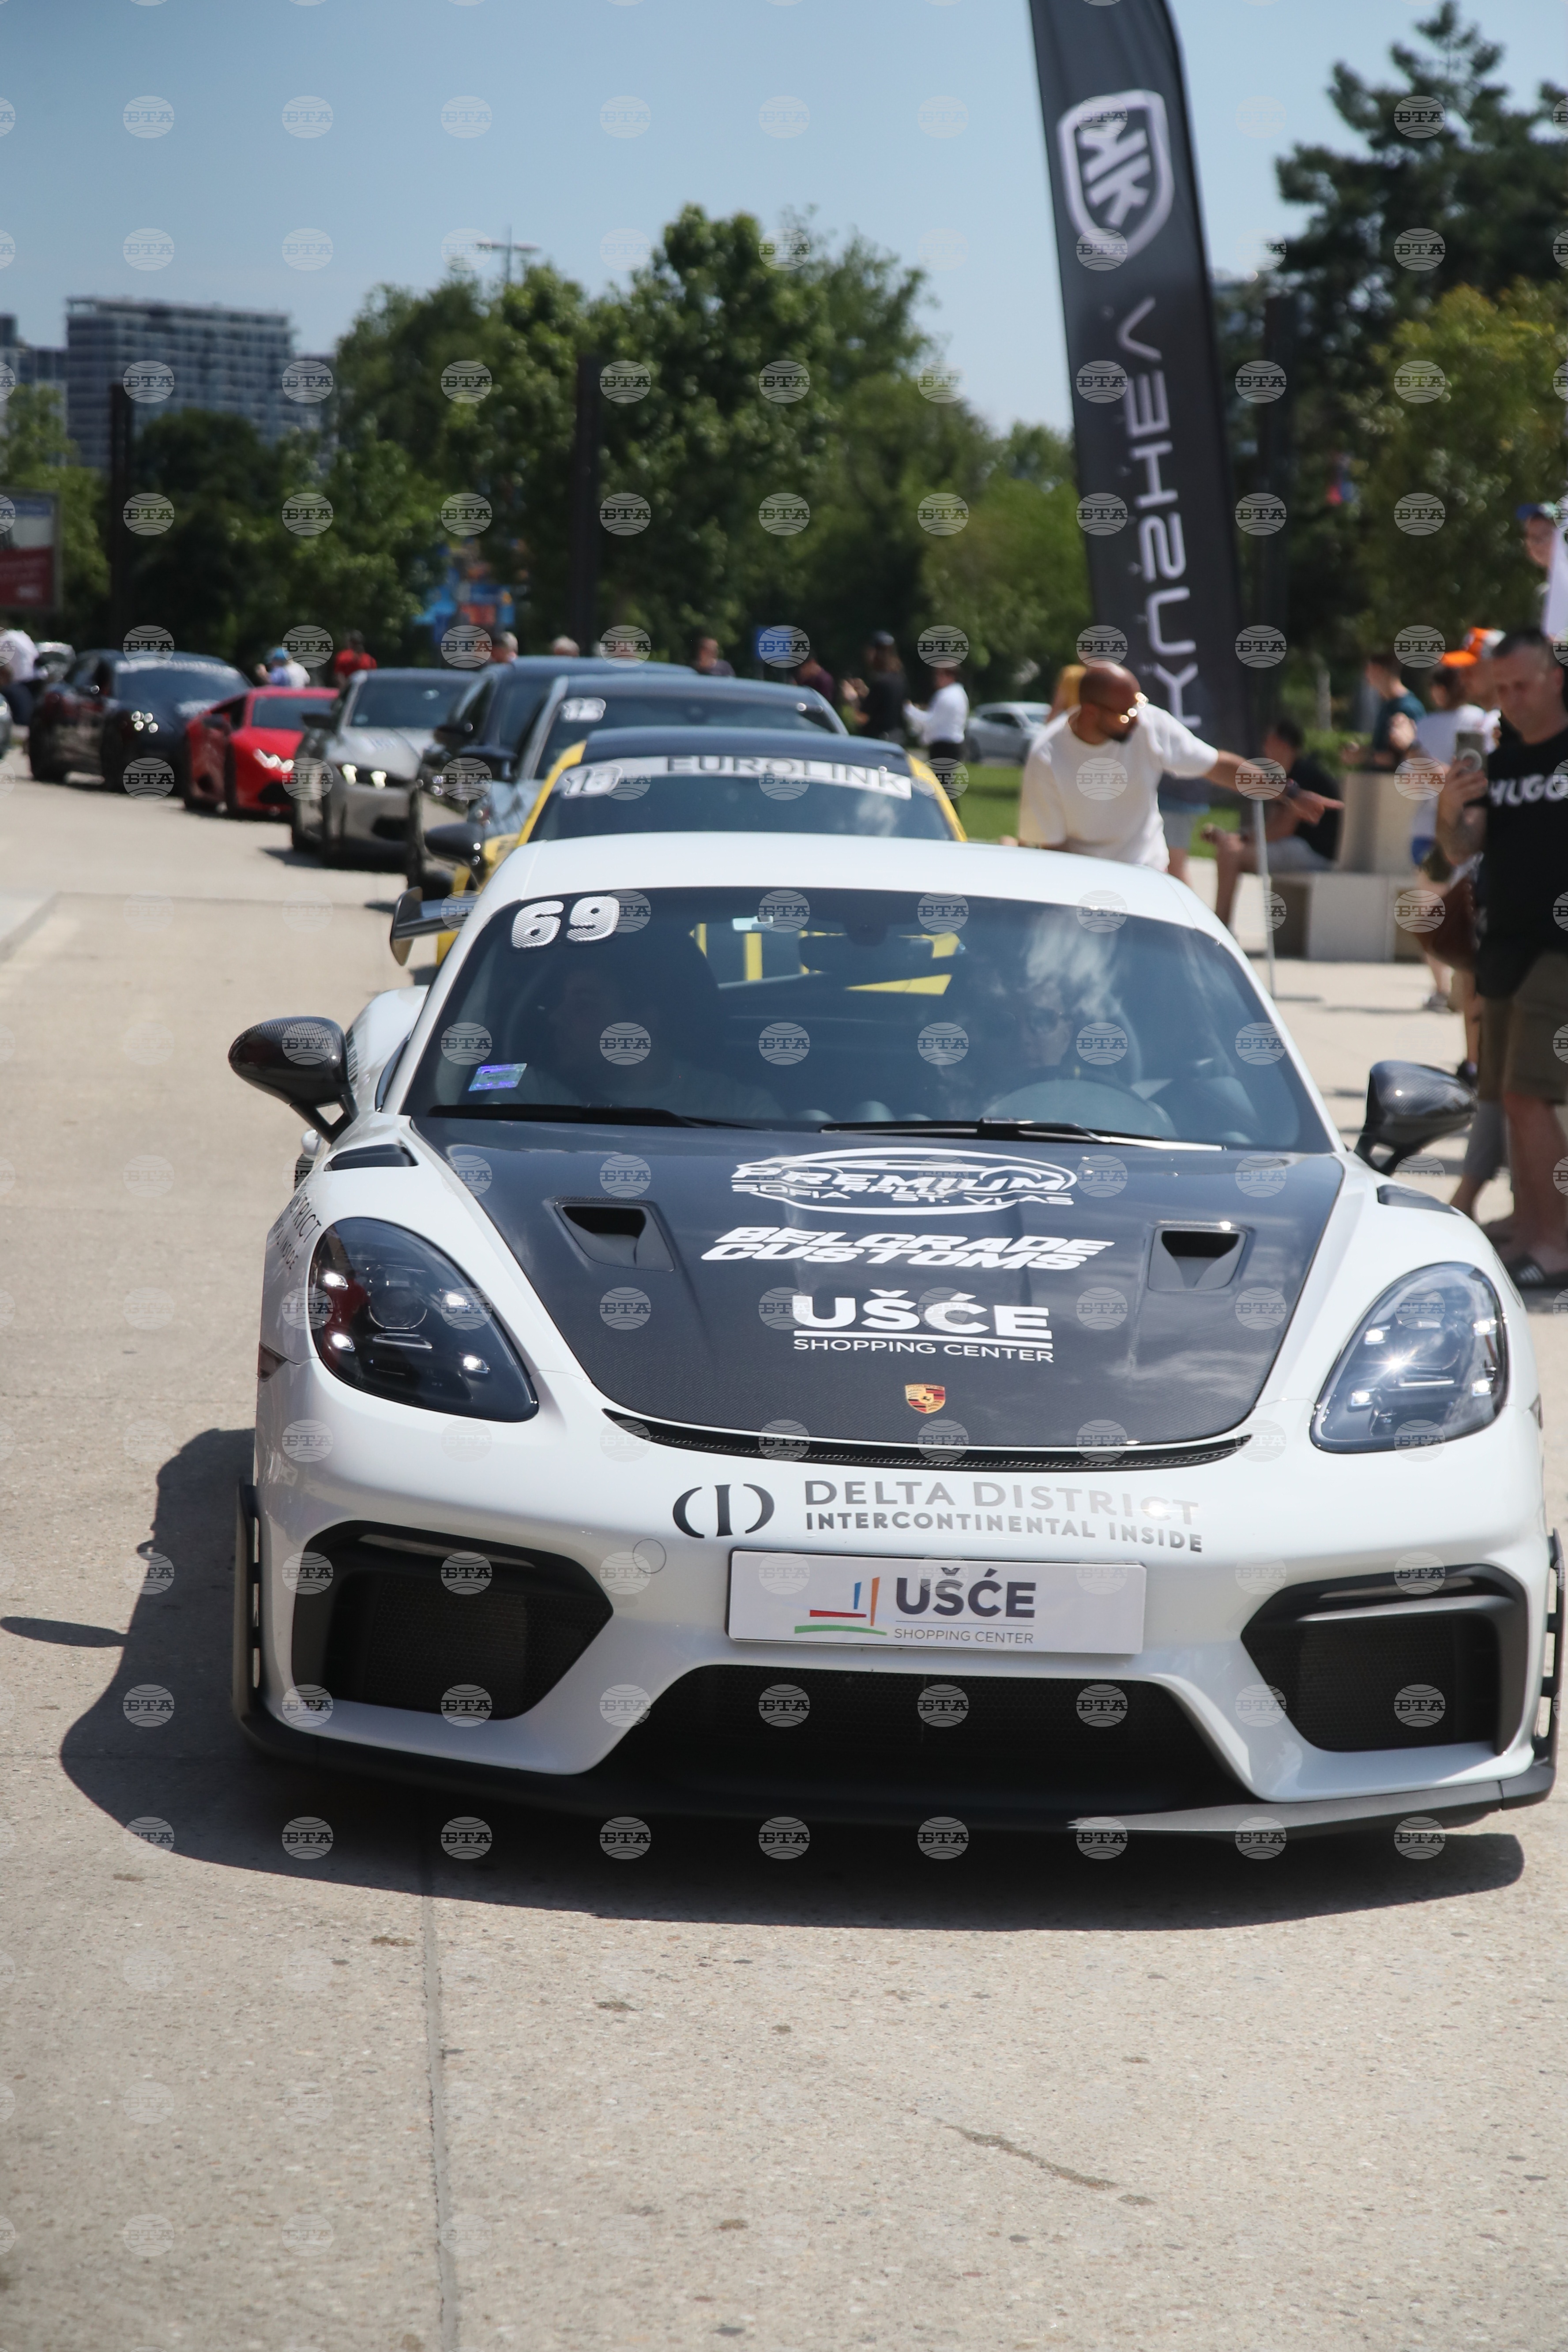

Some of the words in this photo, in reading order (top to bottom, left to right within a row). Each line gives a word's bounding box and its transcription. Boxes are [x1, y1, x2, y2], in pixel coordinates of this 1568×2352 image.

[668, 755, 909, 793] EUROLINK
[512, 896, 620, 948] 69
[731, 1167, 1066, 1191] PREMIUM
[732, 1184, 851, 1199] SOFIA
[963, 1195, 1074, 1206] VLAS
[700, 1243, 1087, 1270] CUSTOMS
[714, 1227, 1115, 1256] BELGRADE
[793, 1289, 1053, 1340] UŠĆE
[793, 1339, 936, 1353] SHOPPING
[943, 1344, 1054, 1363] CENTER
[805, 1480, 955, 1505] DELTA
[973, 1482, 1199, 1525] DISTRICT
[807, 1511, 1096, 1538] INTERCONTINENTAL
[1109, 1522, 1202, 1552] INSIDE
[896, 1567, 1036, 1618] UŠĆE
[895, 1628, 971, 1642] SHOPPING
[975, 1631, 1034, 1644] CENTER
